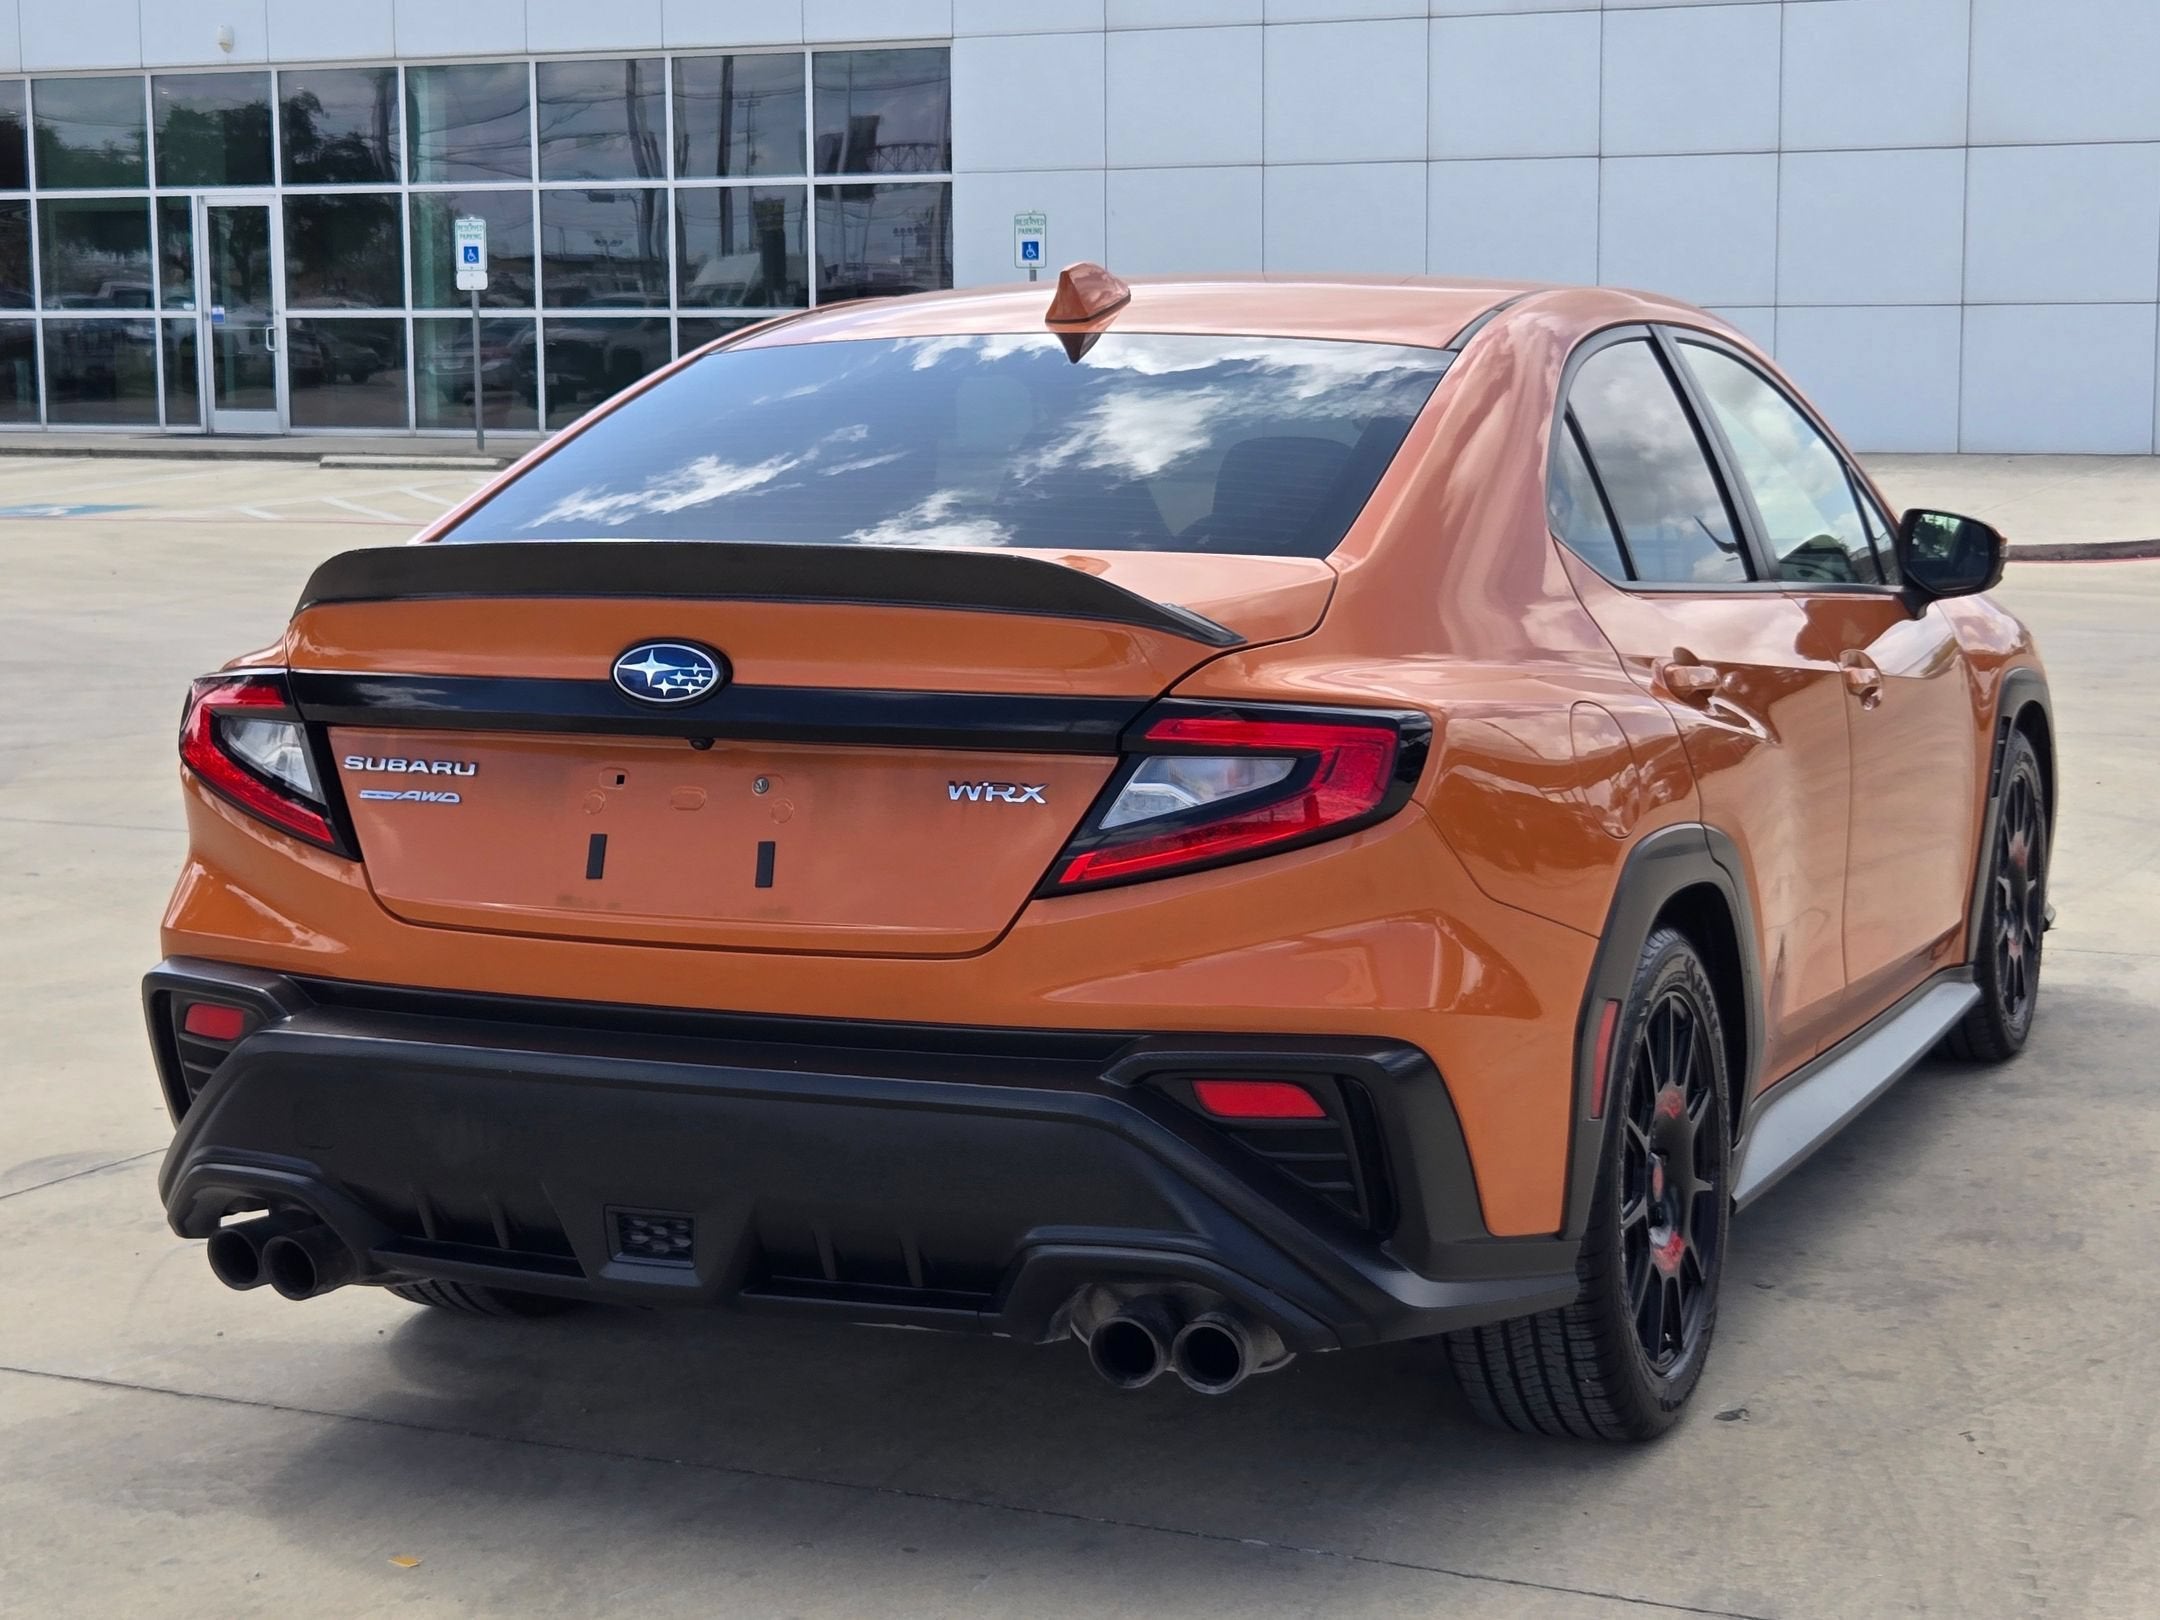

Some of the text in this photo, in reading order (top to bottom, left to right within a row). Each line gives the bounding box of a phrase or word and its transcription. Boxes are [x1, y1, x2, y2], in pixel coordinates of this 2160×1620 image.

[1017, 227, 1043, 235] PARKING
[344, 755, 476, 776] SUBARU
[397, 790, 460, 803] AWD
[947, 780, 1049, 804] WRX
